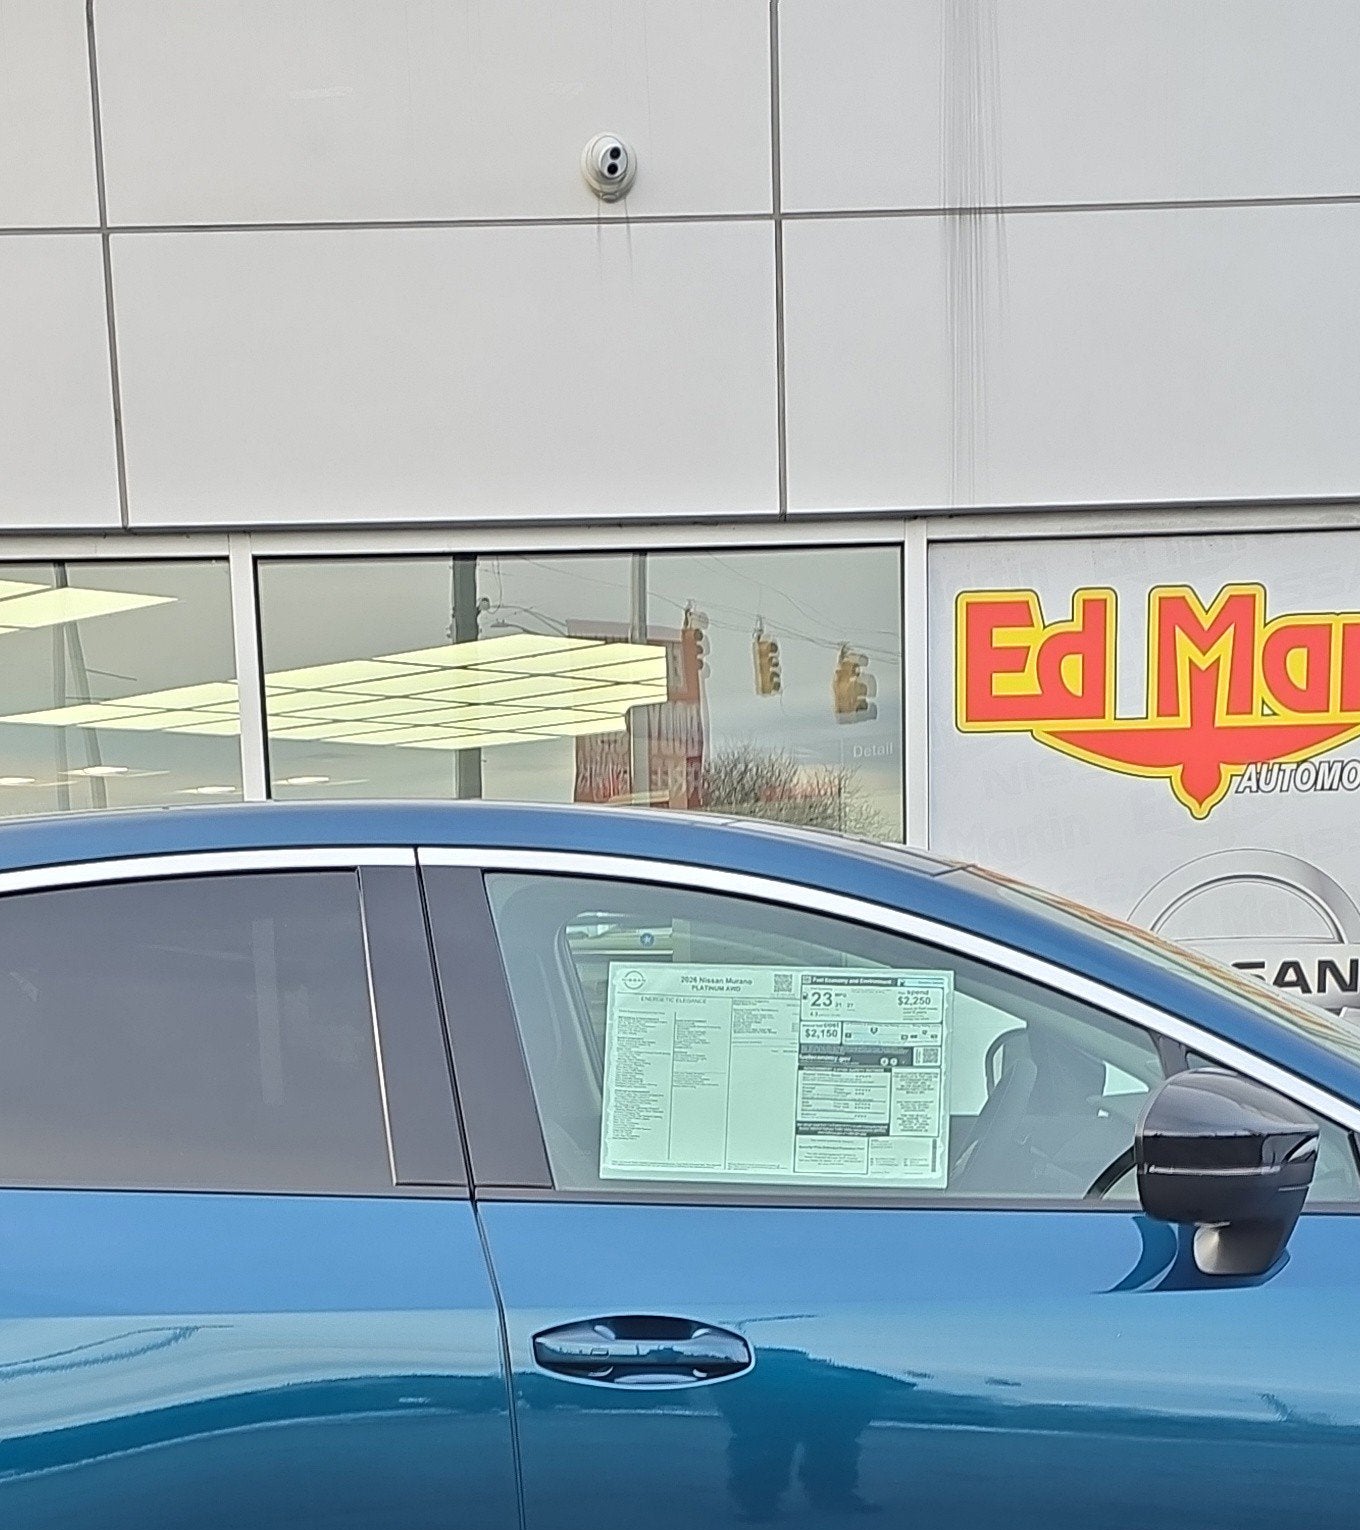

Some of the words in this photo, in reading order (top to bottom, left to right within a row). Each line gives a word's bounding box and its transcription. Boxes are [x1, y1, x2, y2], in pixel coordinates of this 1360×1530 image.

[956, 586, 1117, 732] Ed
[853, 742, 893, 758] Detail
[699, 976, 724, 984] Nissan
[725, 978, 753, 986] Murano
[811, 991, 833, 1007] 23
[897, 996, 932, 1006] $2,250
[804, 1028, 839, 1039] $2,150
